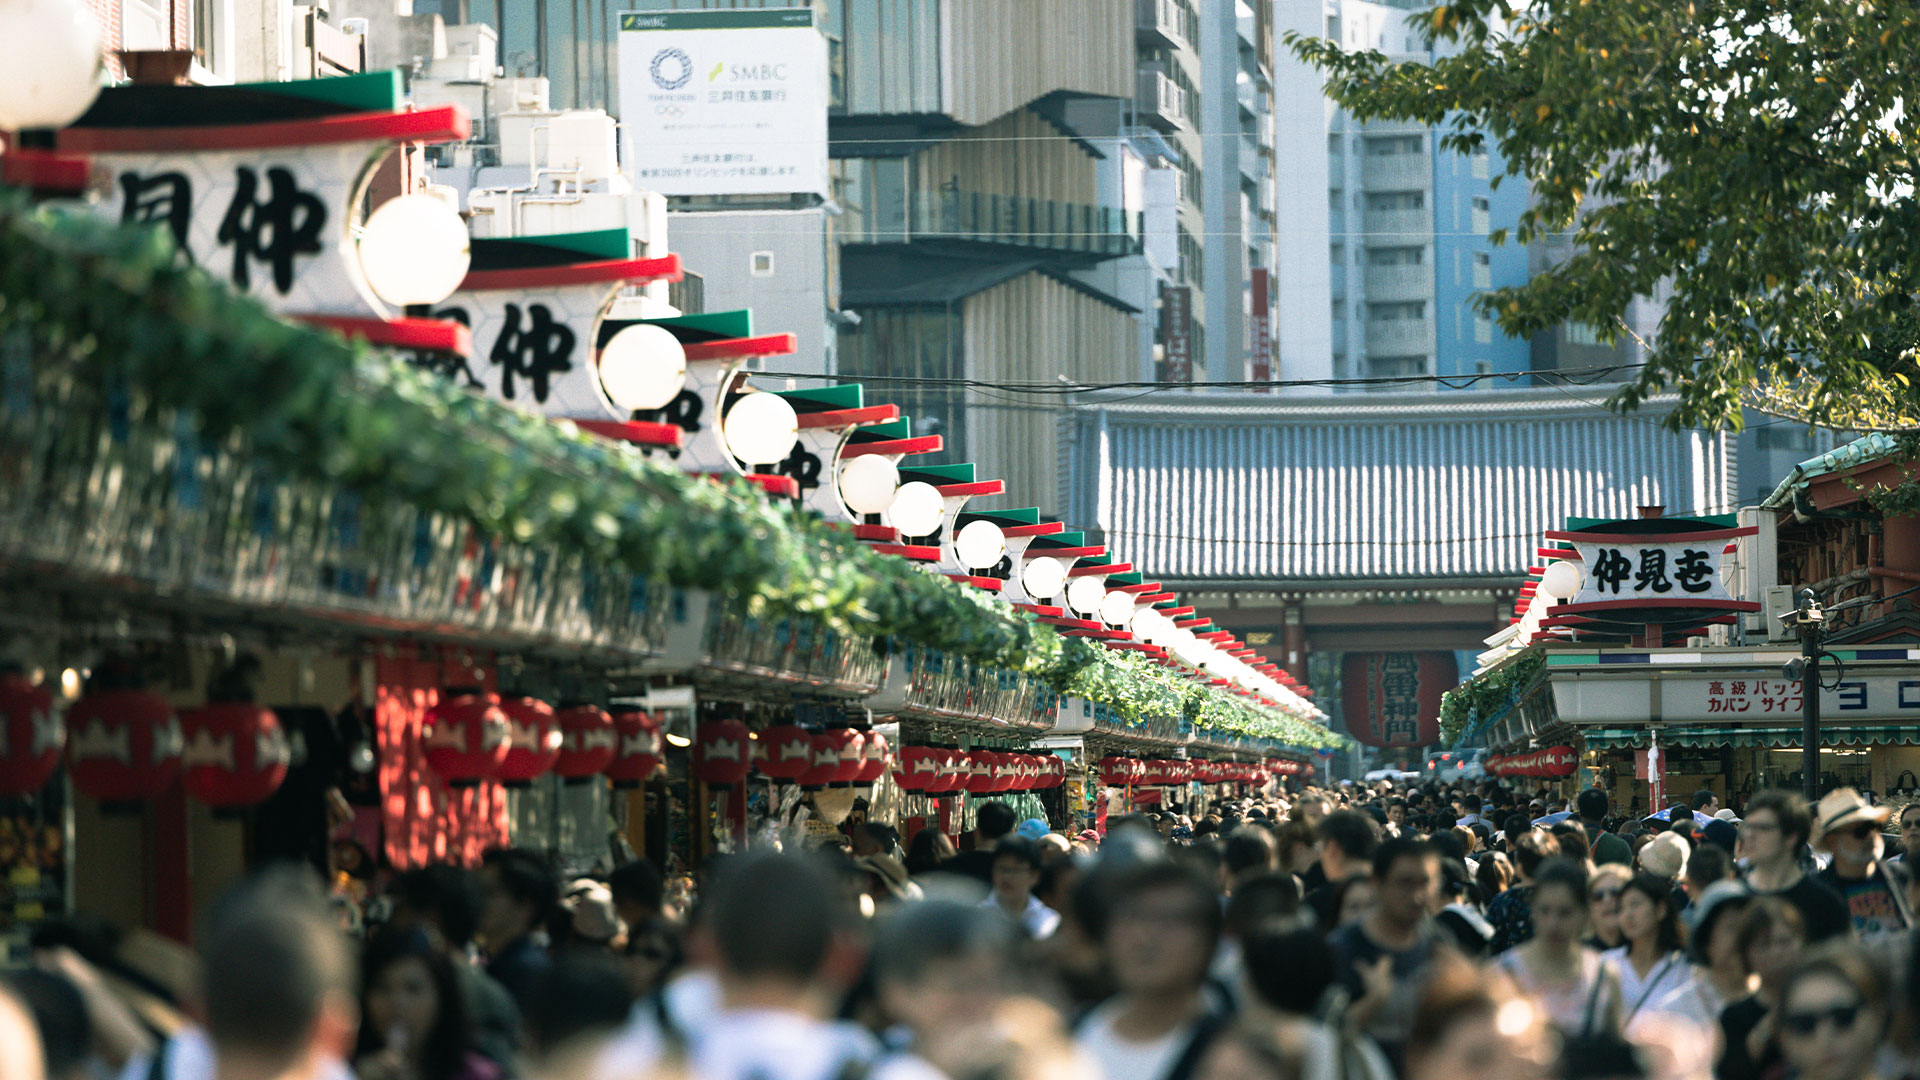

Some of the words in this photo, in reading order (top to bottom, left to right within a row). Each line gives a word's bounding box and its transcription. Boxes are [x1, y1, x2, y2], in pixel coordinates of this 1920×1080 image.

[635, 16, 668, 28] SMBC
[729, 63, 787, 81] SMBC
[1592, 548, 1713, 594] 仲見世
[1709, 680, 1747, 696] 高級
[1708, 697, 1751, 713] カバン
